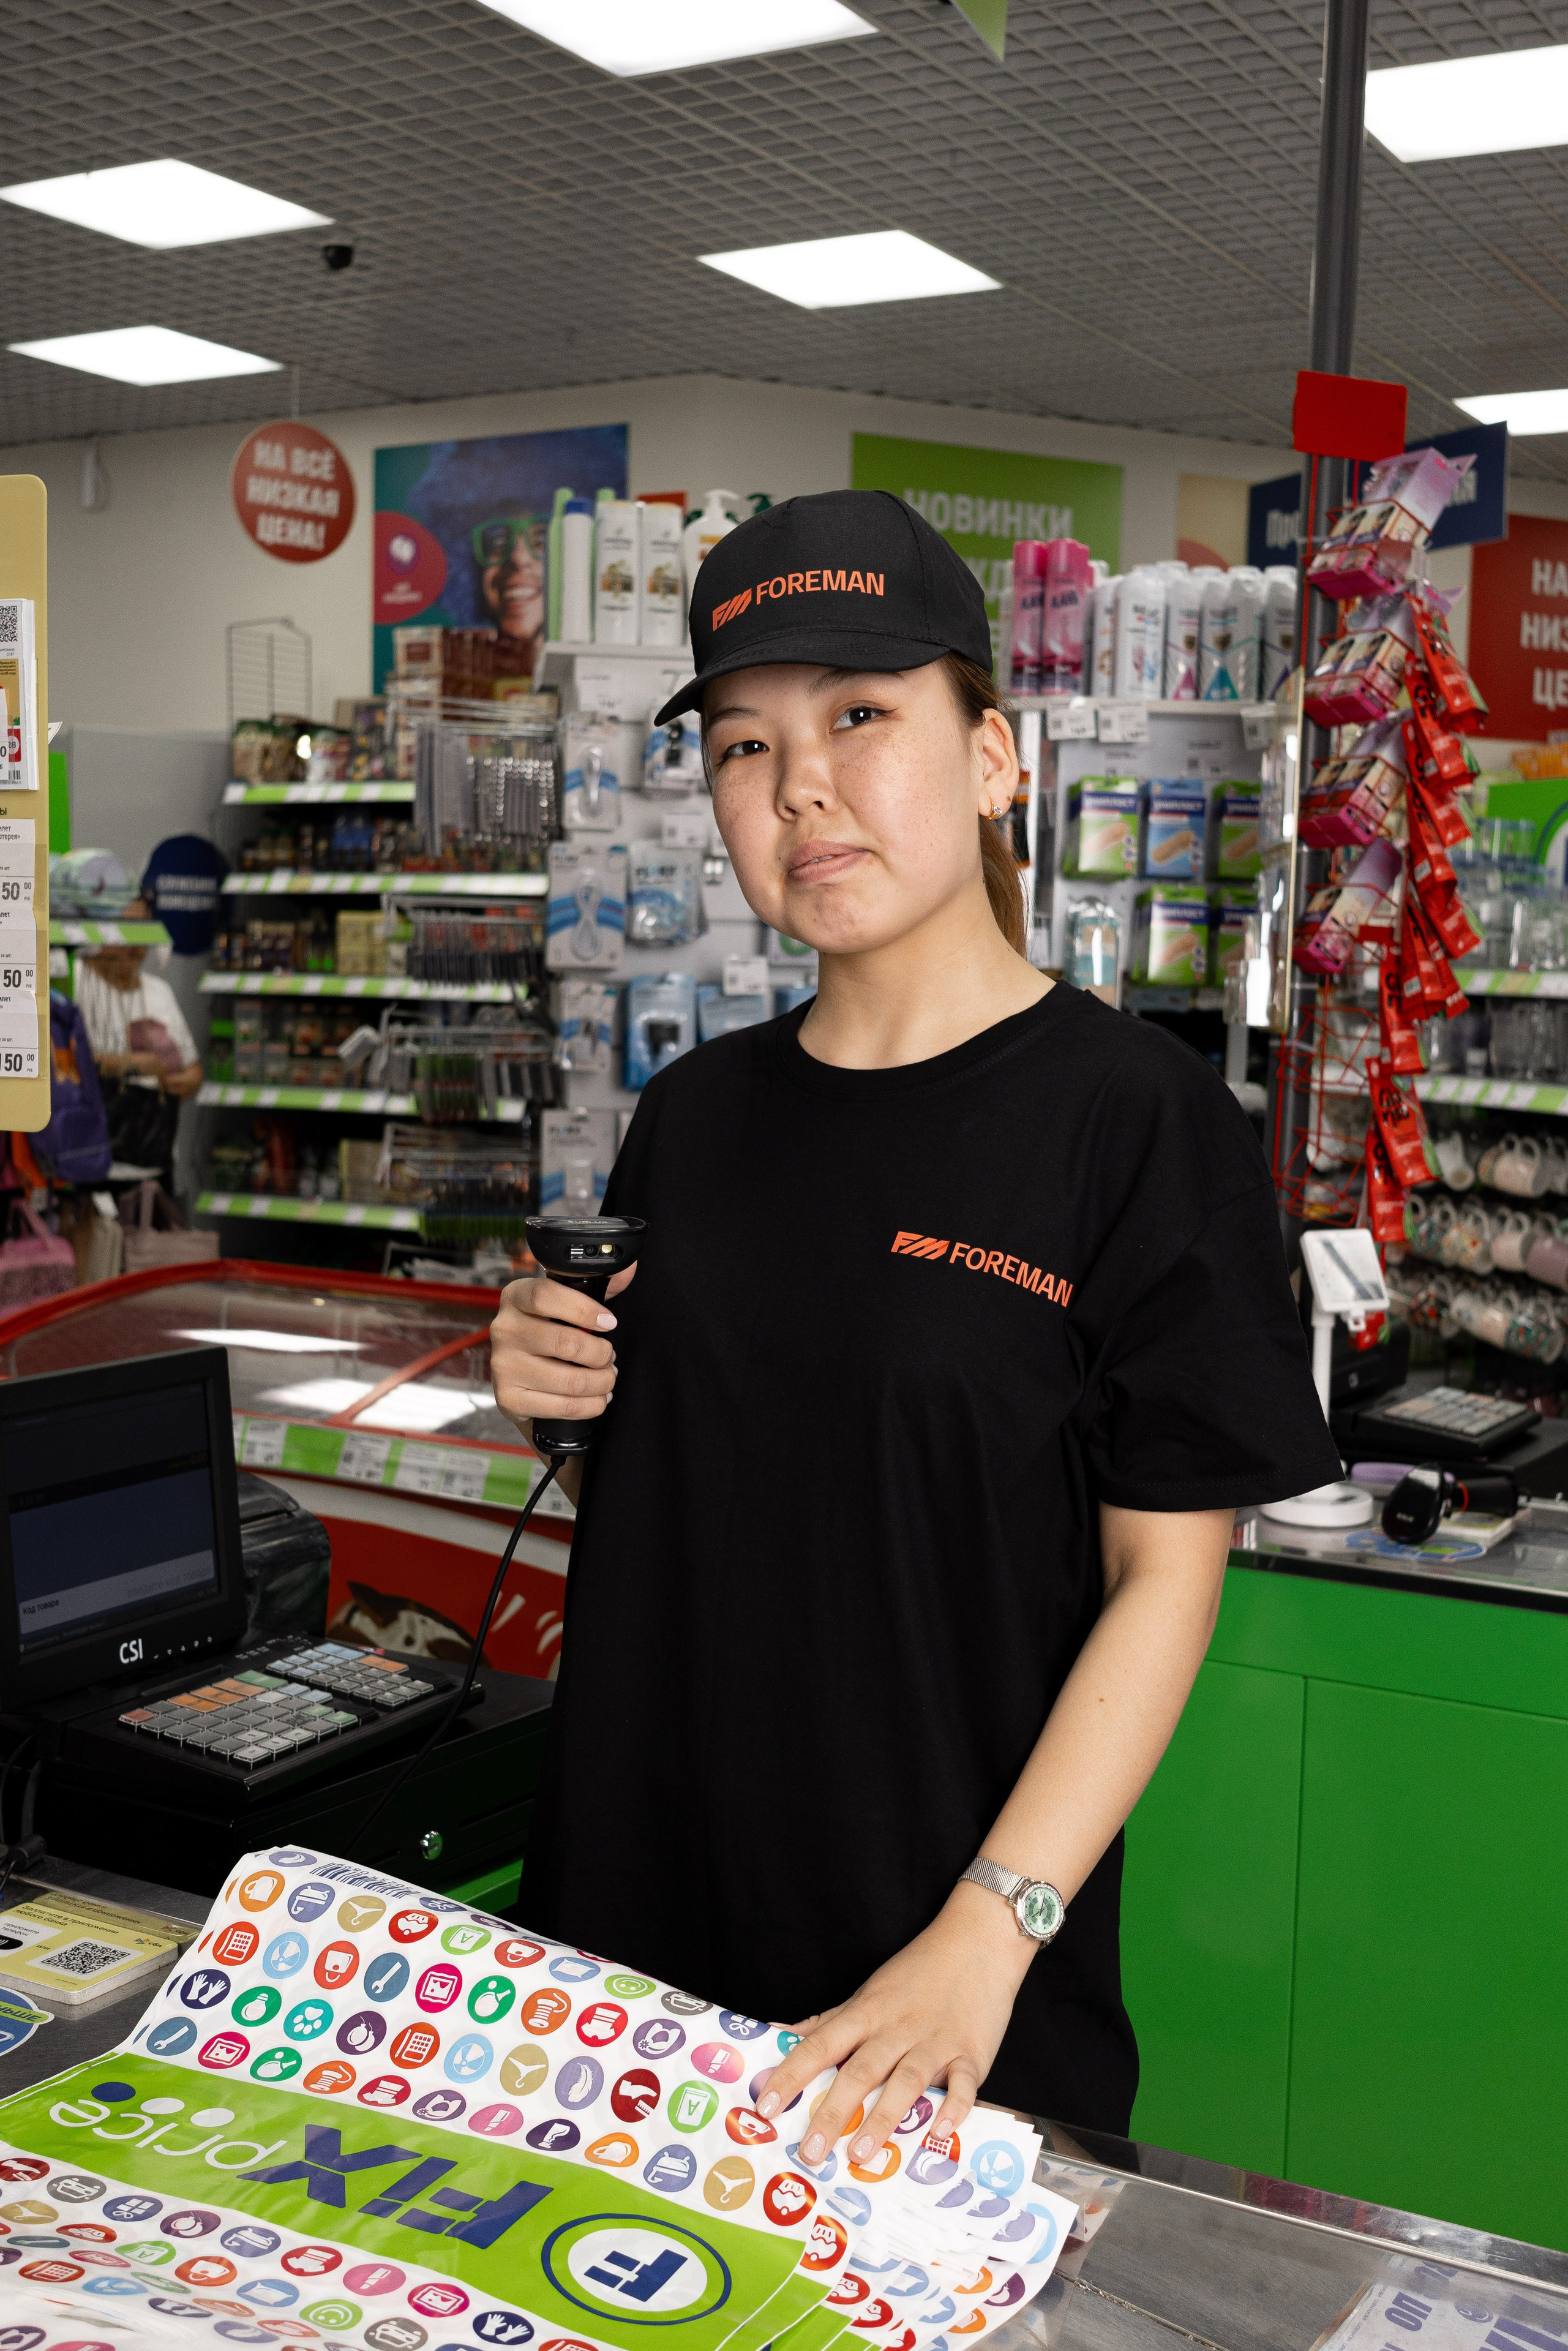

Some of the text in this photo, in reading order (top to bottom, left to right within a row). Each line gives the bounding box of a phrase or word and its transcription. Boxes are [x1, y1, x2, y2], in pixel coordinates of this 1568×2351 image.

[253, 439, 287, 472] НА
[246, 474, 340, 519] НИЗКАЯ
[257, 513, 327, 552] ЦЕНА!
[756, 570, 885, 606] FOREMAN
[2, 882, 20, 901] 50
[949, 1242, 1073, 1307] FOREMAN
[23, 1599, 59, 1615] Код товара
[119, 1638, 143, 1664] CSI
[1, 1927, 29, 1937] телефон
[4, 1922, 40, 1935] приложите
[13, 1908, 68, 1927] любого банка
[22, 1905, 64, 1920] Заплатите
[69, 1918, 119, 1935] приложении
[50, 2099, 554, 2250] FIX price
